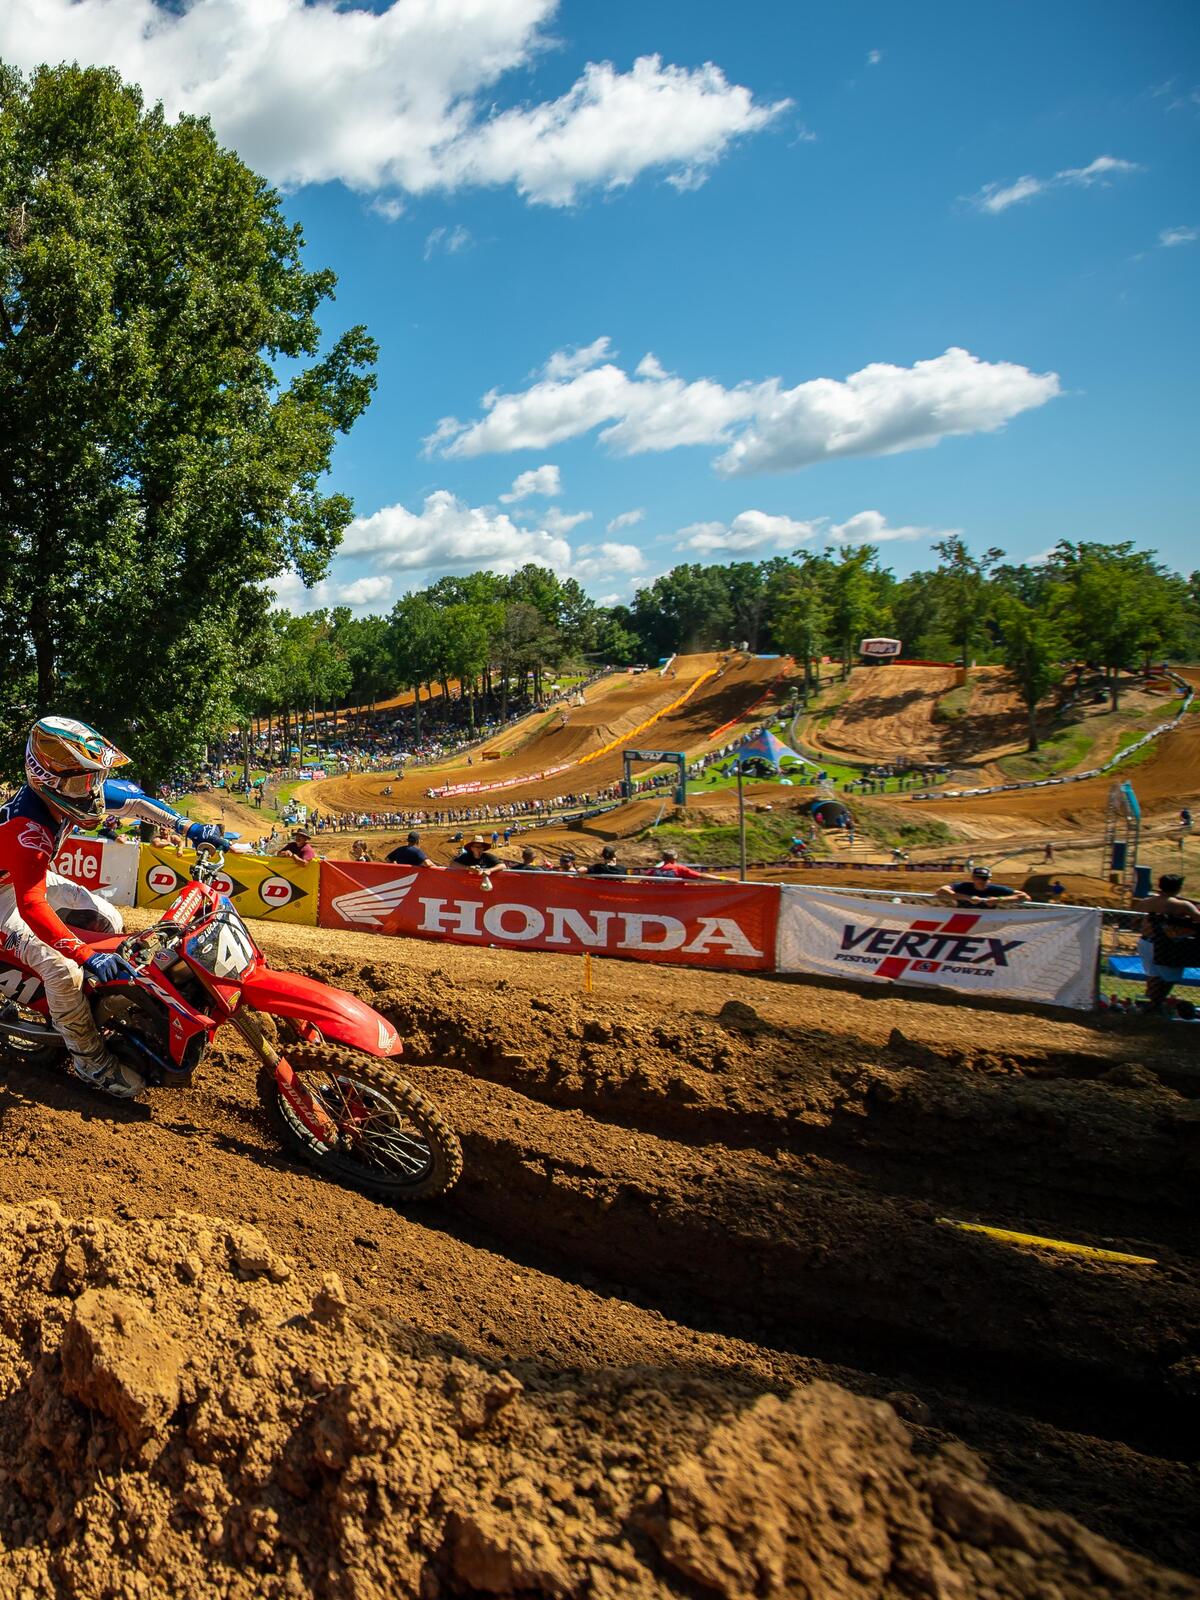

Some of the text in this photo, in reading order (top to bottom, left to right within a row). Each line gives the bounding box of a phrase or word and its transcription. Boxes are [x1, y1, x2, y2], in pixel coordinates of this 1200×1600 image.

[49, 847, 98, 879] ate
[151, 873, 175, 886] D
[263, 885, 290, 898] D
[417, 896, 765, 959] HONDA
[840, 924, 1026, 967] VERTEX
[833, 953, 882, 966] PISTON
[940, 964, 997, 977] POWER
[281, 1081, 321, 1127] DUNLOP
